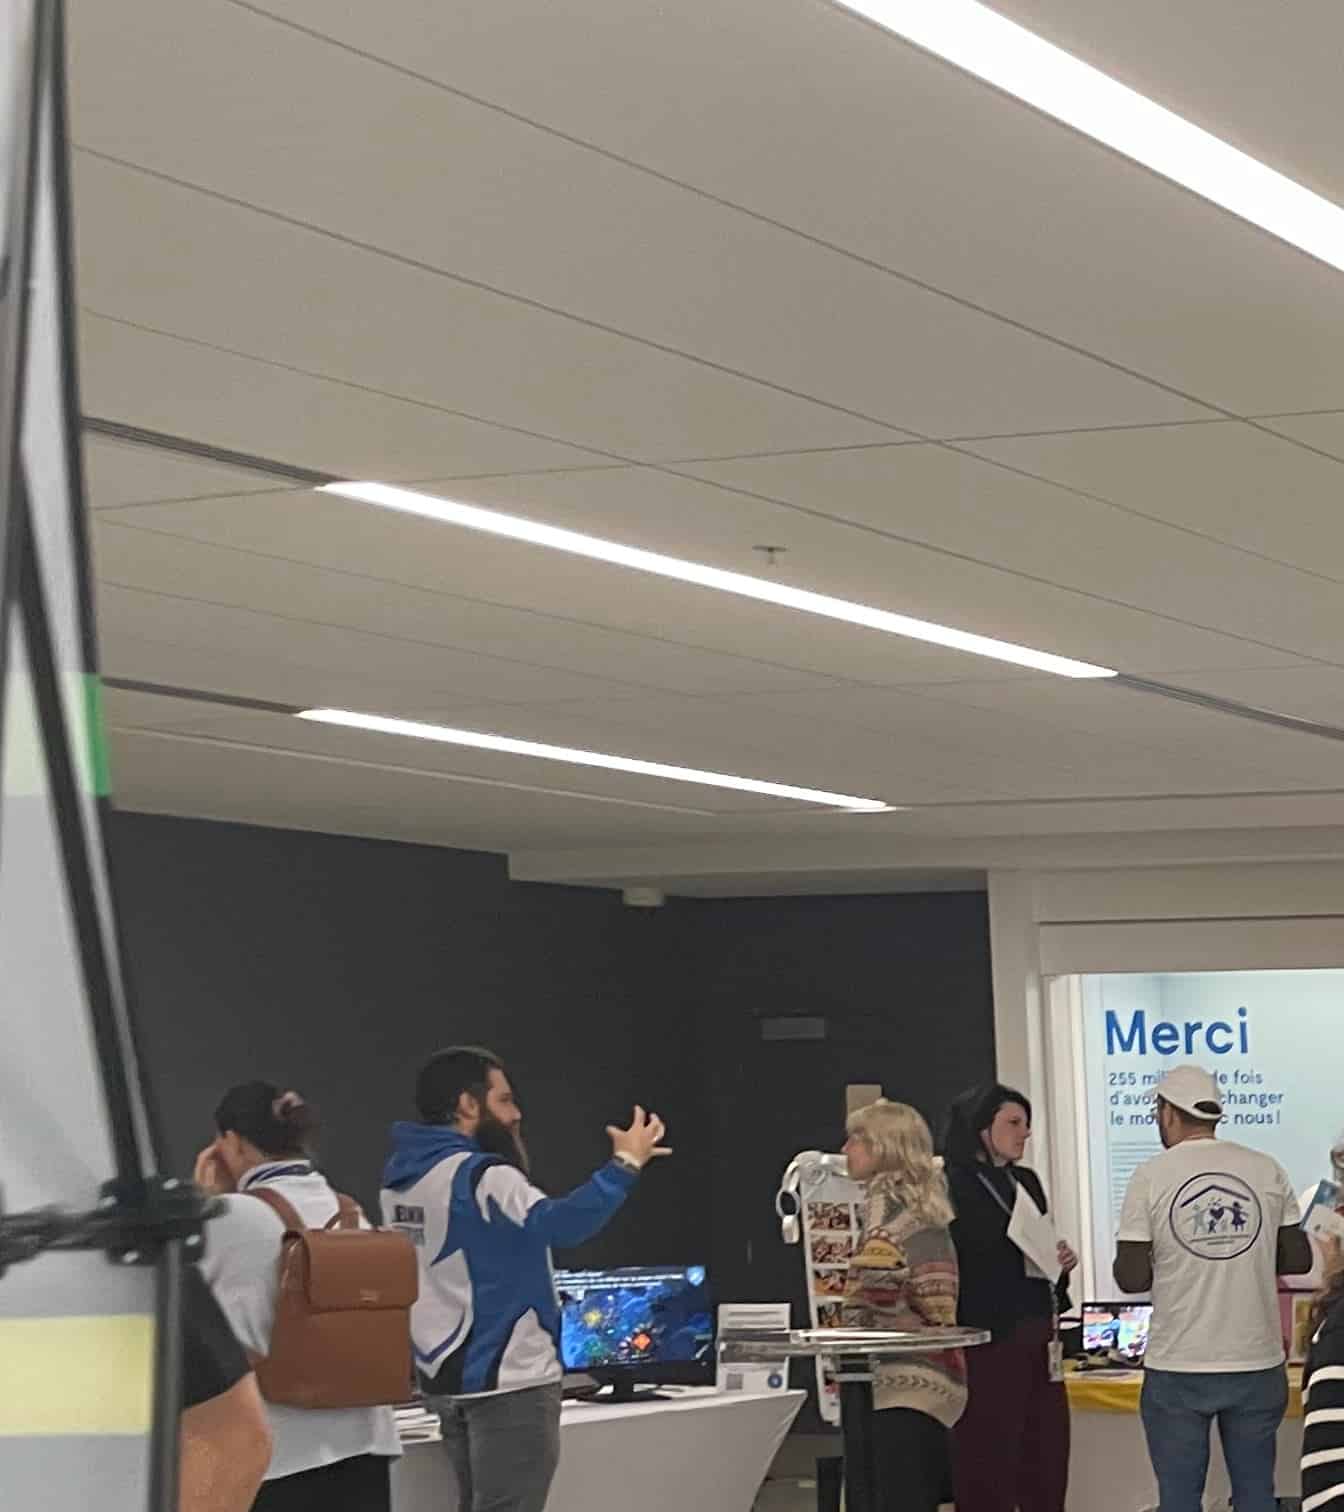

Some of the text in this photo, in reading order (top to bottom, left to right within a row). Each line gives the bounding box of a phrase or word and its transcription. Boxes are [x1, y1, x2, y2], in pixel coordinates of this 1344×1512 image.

[1105, 1006, 1249, 1055] Merci
[1109, 1072, 1137, 1086] 255
[1234, 1069, 1263, 1084] fois
[1111, 1110, 1124, 1125] le
